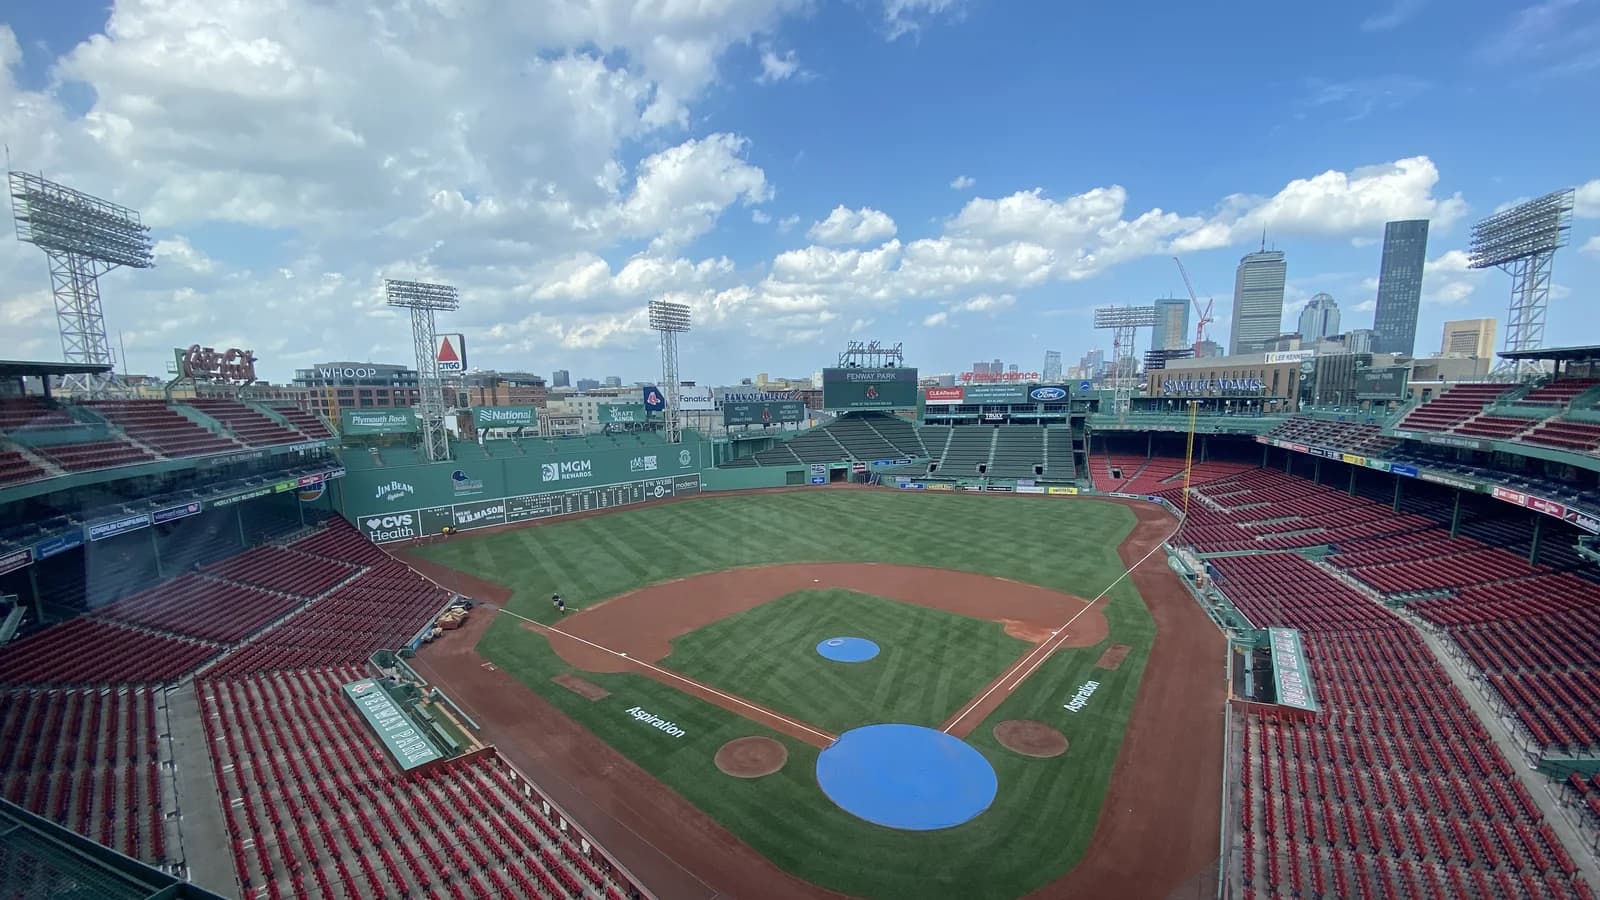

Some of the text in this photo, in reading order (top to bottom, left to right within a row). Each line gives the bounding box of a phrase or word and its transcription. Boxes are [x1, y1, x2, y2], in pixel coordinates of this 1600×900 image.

[319, 367, 377, 378] WHOOP
[759, 392, 791, 400] AMERICA
[1037, 390, 1059, 398] Ford
[352, 415, 407, 425] Plymouth Rock
[492, 410, 531, 420] National
[561, 459, 592, 473] MGM
[561, 471, 593, 480] REWARDS
[375, 484, 391, 498] JIM
[391, 481, 414, 495] BEAM
[474, 505, 504, 519] MASON
[381, 514, 413, 528] CVS
[369, 526, 414, 542] Health
[1063, 680, 1101, 712] Aspiration
[360, 691, 434, 763] FENWAY PARK
[625, 706, 686, 738] Aspiration
